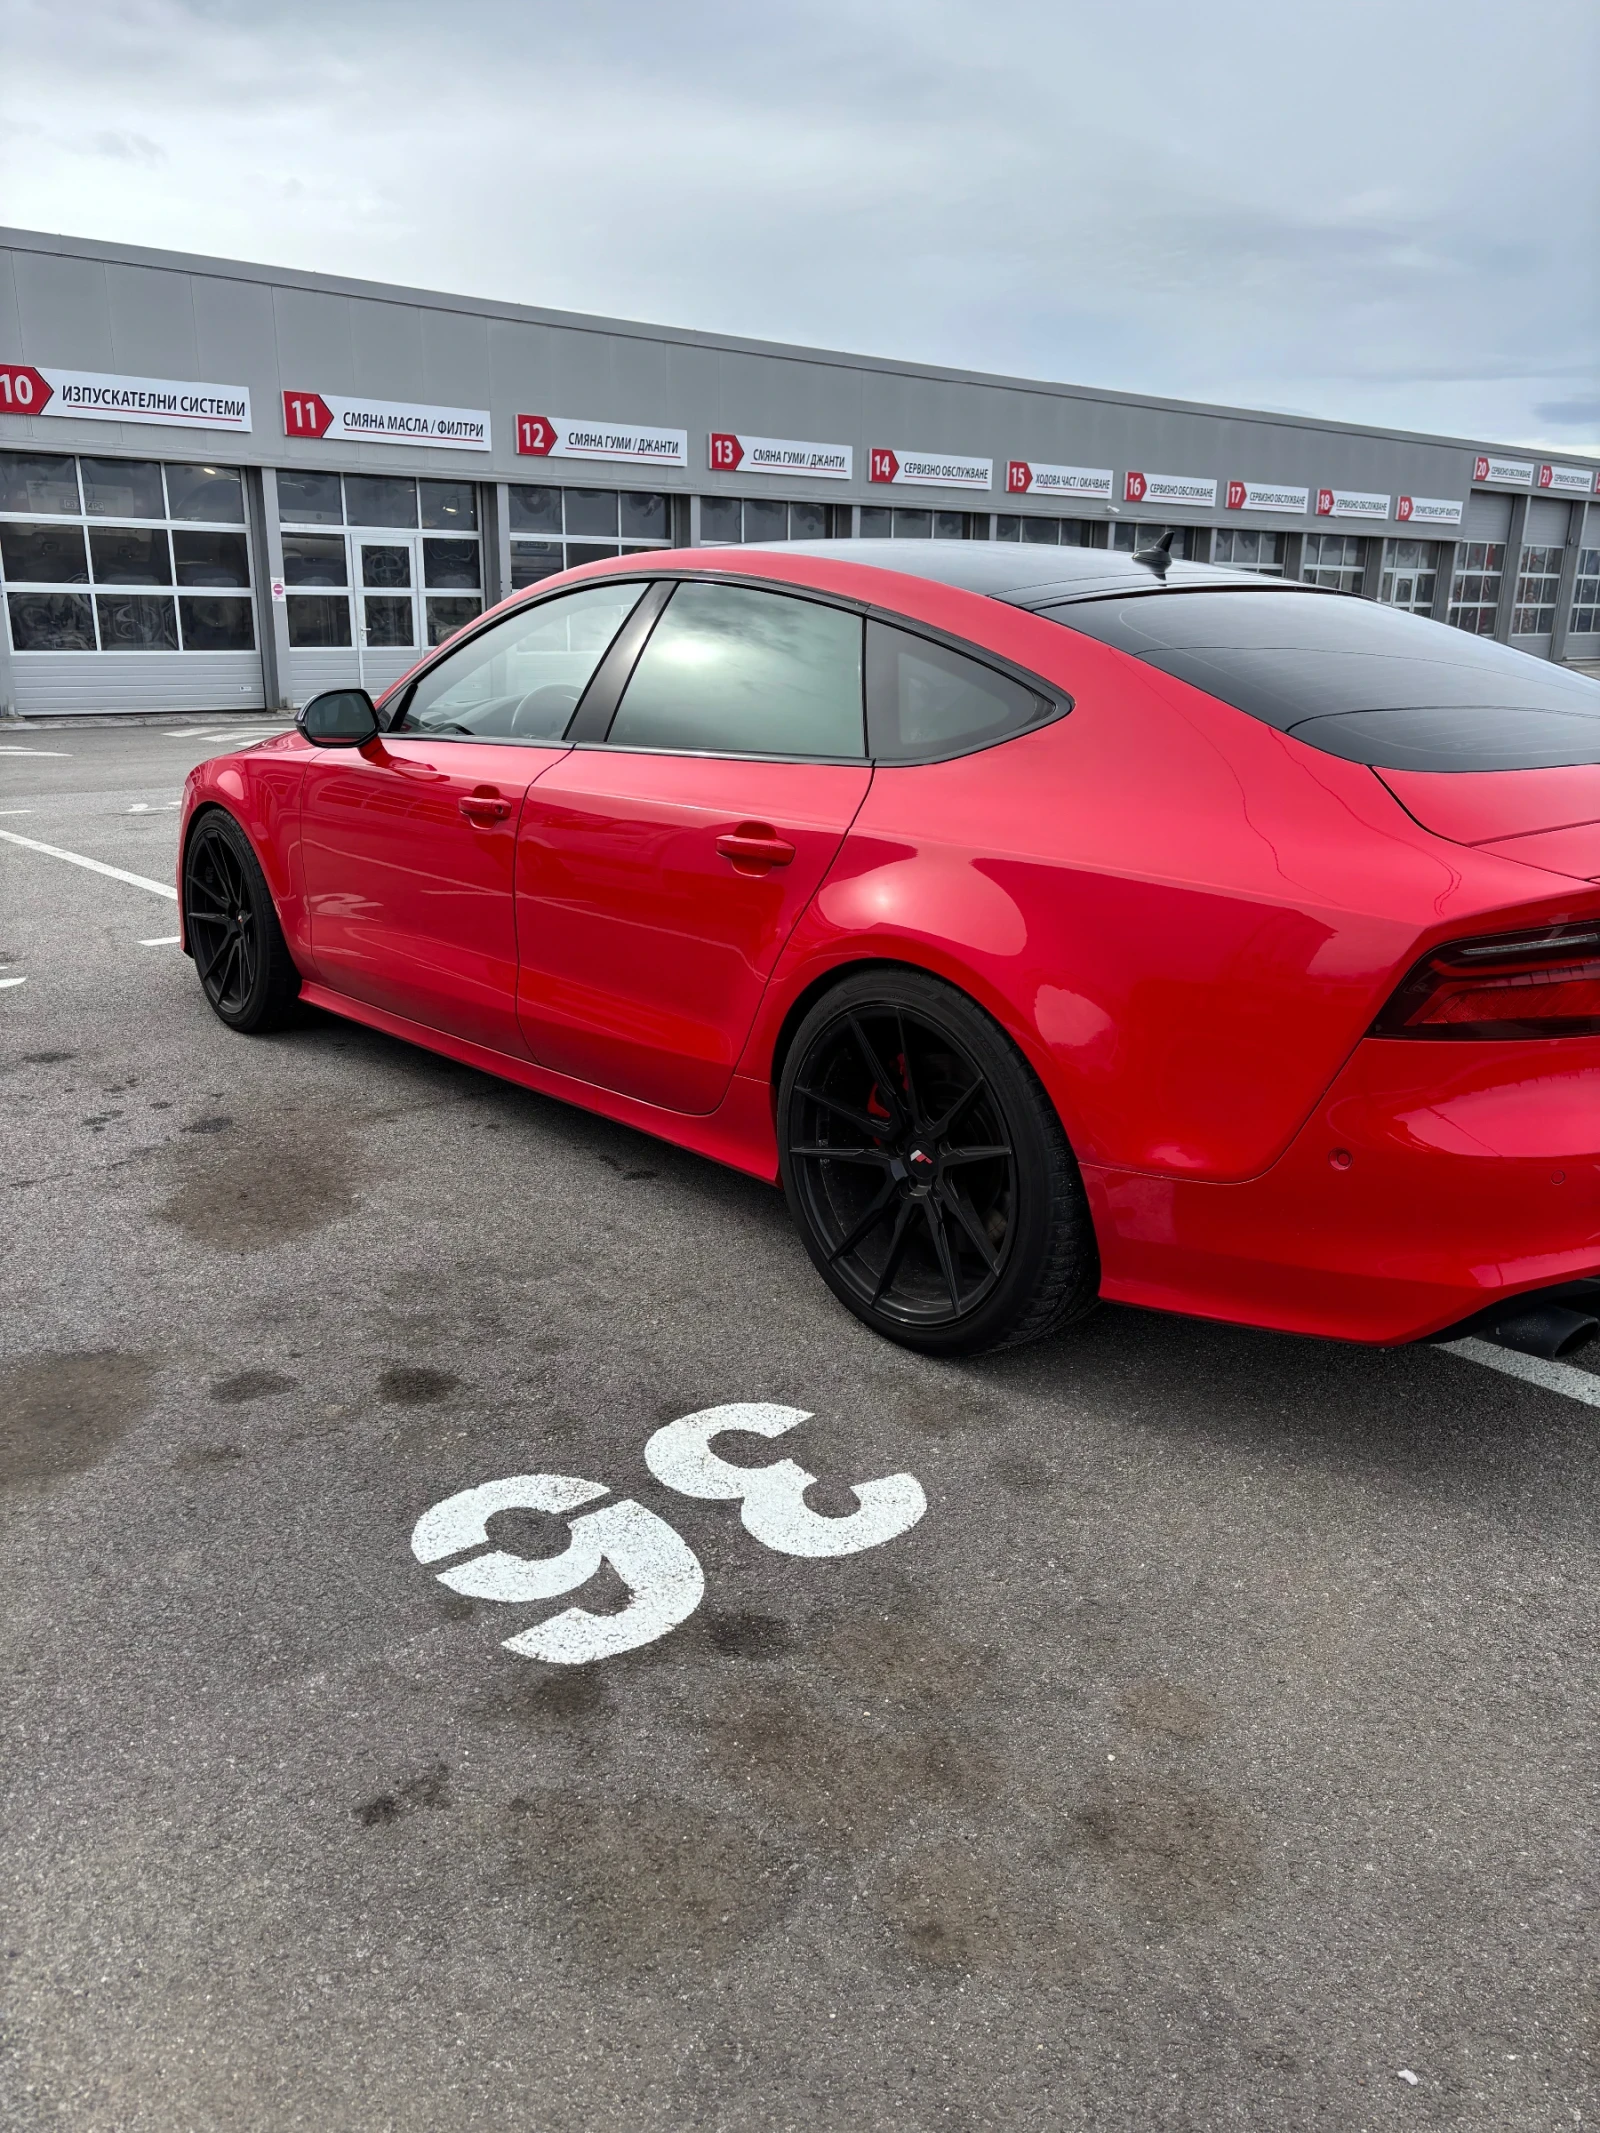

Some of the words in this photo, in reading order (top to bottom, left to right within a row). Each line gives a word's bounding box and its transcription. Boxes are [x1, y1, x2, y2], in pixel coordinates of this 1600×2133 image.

[0, 373, 33, 405] 10
[62, 385, 177, 411] ИЗПУСКАТЕЛНИ
[180, 395, 246, 417] СИСТЕМИ
[291, 400, 317, 429] 11
[343, 411, 385, 429] СМЯНА
[387, 416, 429, 433] МАСЛА
[430, 419, 437, 434] /
[437, 419, 484, 437] ФИЛТРИ
[522, 422, 545, 448] 12
[568, 432, 603, 448] СМЯНА
[604, 435, 632, 450] ГУМИ
[632, 437, 638, 451] /
[637, 438, 679, 454] ДЖАНТИ
[714, 440, 734, 464] 13
[753, 448, 782, 463] СМЯНА
[782, 451, 806, 465] ГУМИ
[810, 454, 846, 468] ДЖАНТИ
[874, 455, 891, 477] 14
[904, 462, 941, 476] СЕРВИЗНО
[941, 465, 989, 480] ОБСЛУЖВАНЕ
[1477, 461, 1487, 476] 20
[1542, 469, 1550, 483] 21
[1011, 467, 1025, 487] 15
[1035, 473, 1060, 487] ХОДОВА
[1061, 475, 1076, 487] ЧАСТ
[1080, 477, 1111, 490] ОКАЧВАНЕ
[1129, 477, 1141, 496] 16
[1150, 483, 1178, 495] СЕРВИЗНО
[1178, 485, 1214, 498] ОБСЛУЖВАНЕ
[1231, 486, 1242, 504] 17
[1320, 494, 1331, 511] 18
[1400, 500, 1410, 516] 19
[411, 1402, 928, 1665] 36
